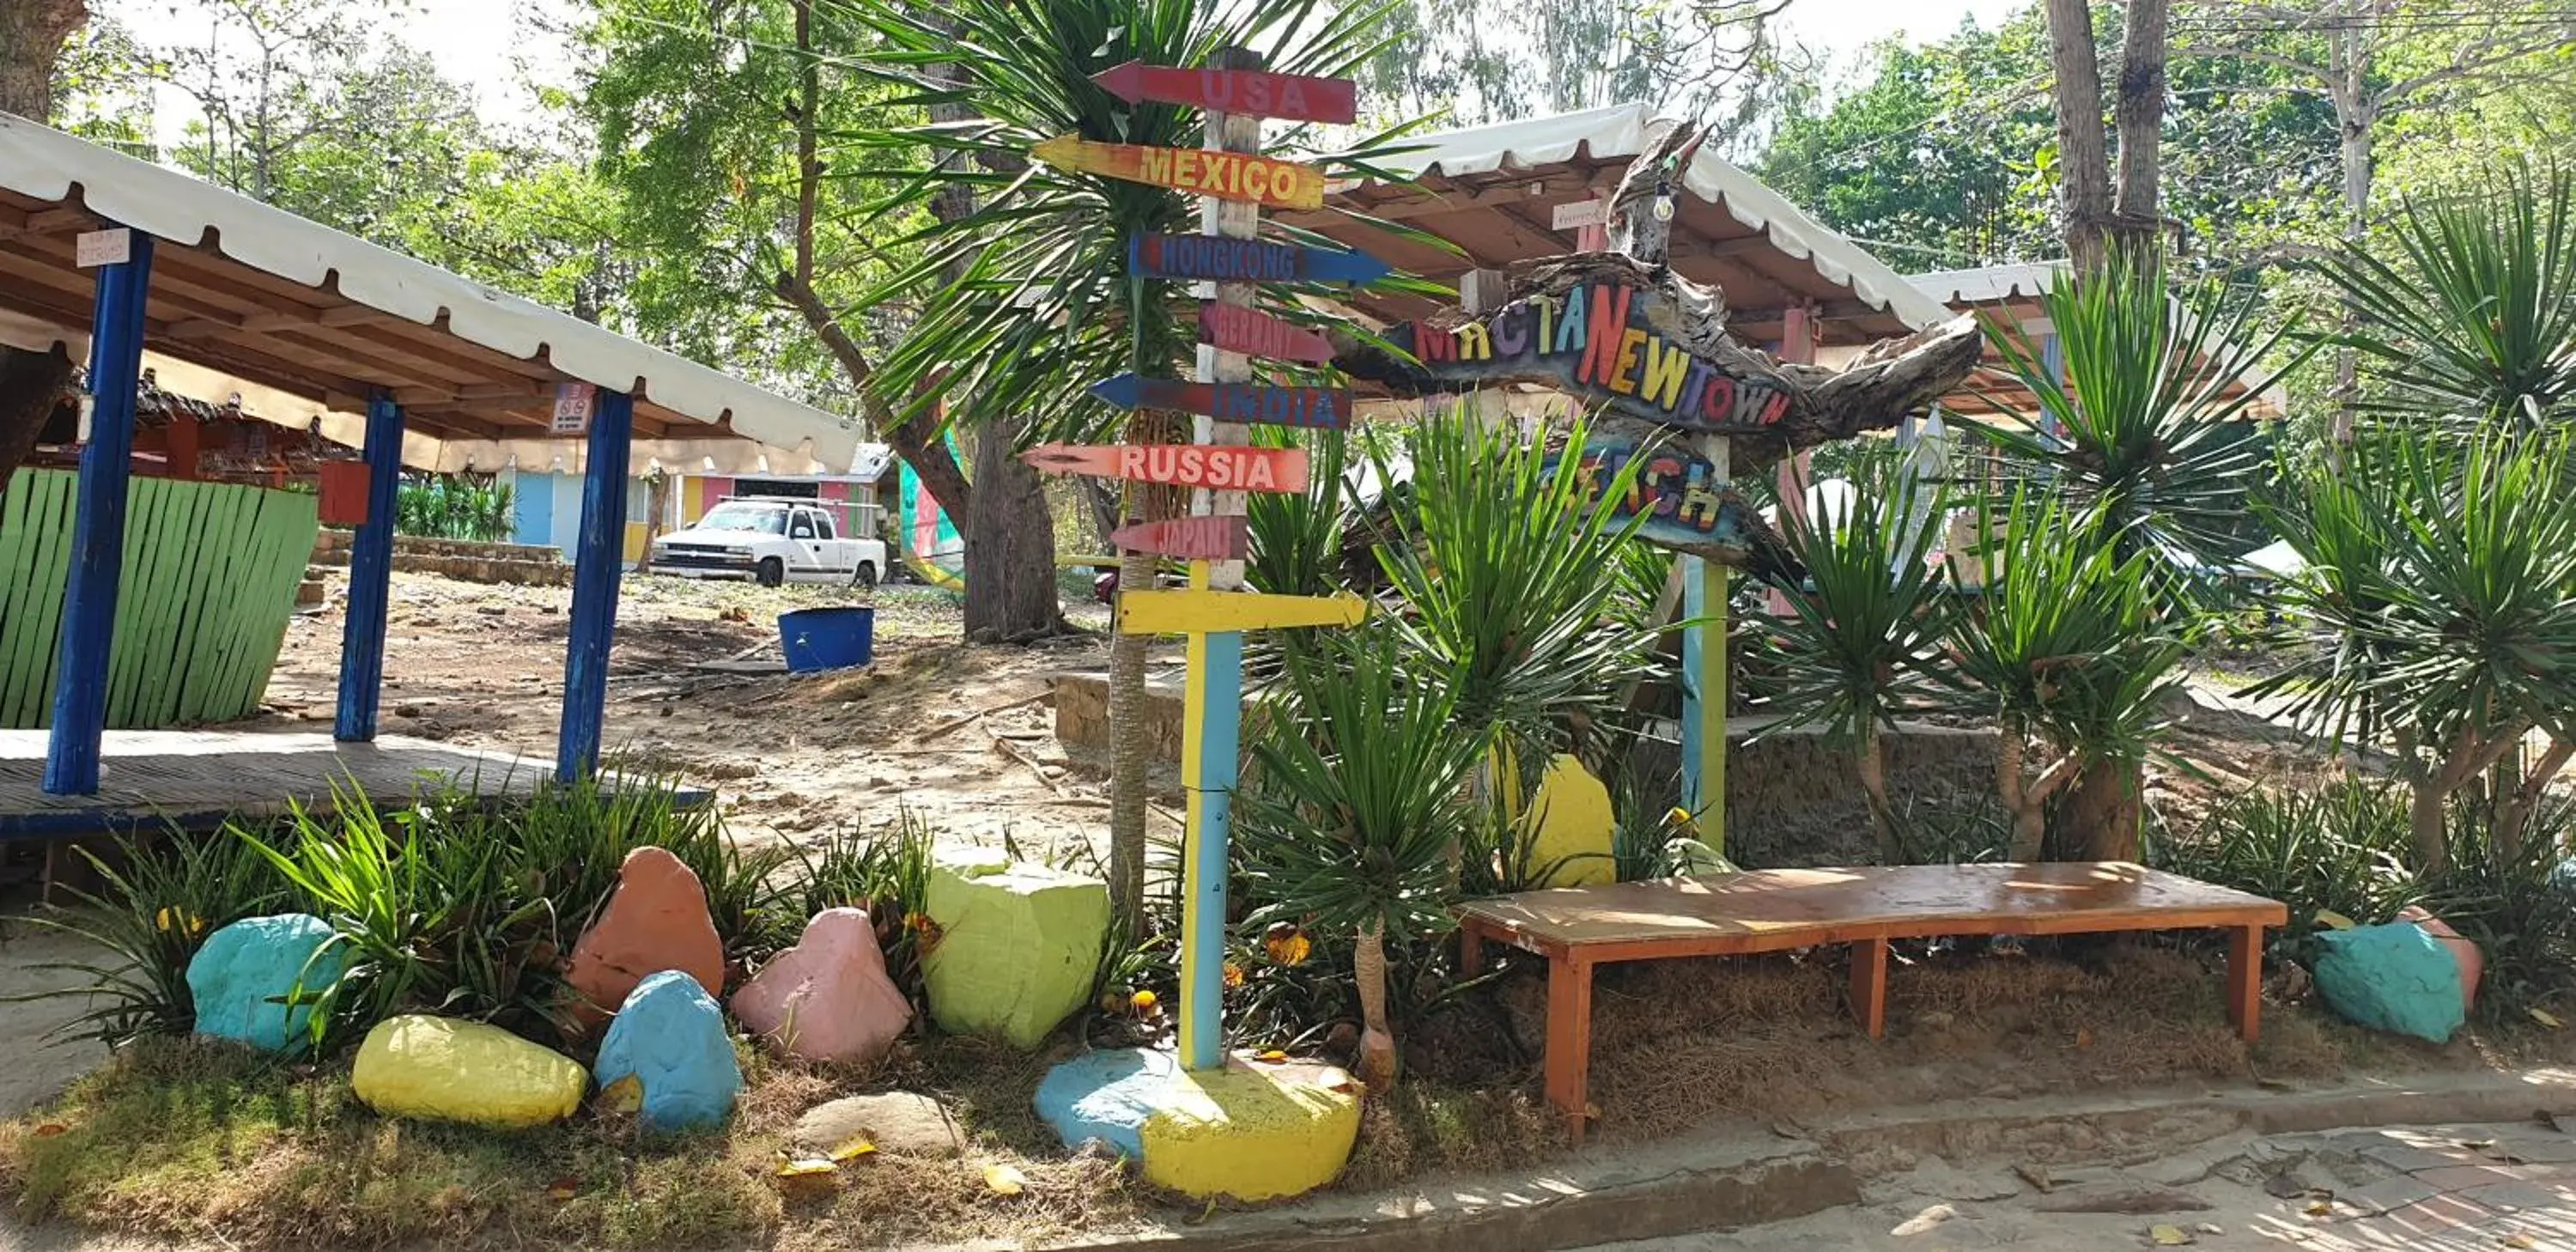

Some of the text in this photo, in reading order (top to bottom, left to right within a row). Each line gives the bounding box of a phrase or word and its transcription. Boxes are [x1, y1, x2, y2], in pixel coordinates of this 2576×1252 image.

[1204, 70, 1309, 114] USA
[1140, 146, 1298, 200] MEXICO
[1162, 236, 1294, 277] HONGKONG
[1217, 307, 1291, 358] GERMANY
[1213, 386, 1339, 428] INDIA
[1120, 446, 1275, 489] RUSSIA
[1157, 517, 1222, 556] JAPAN
